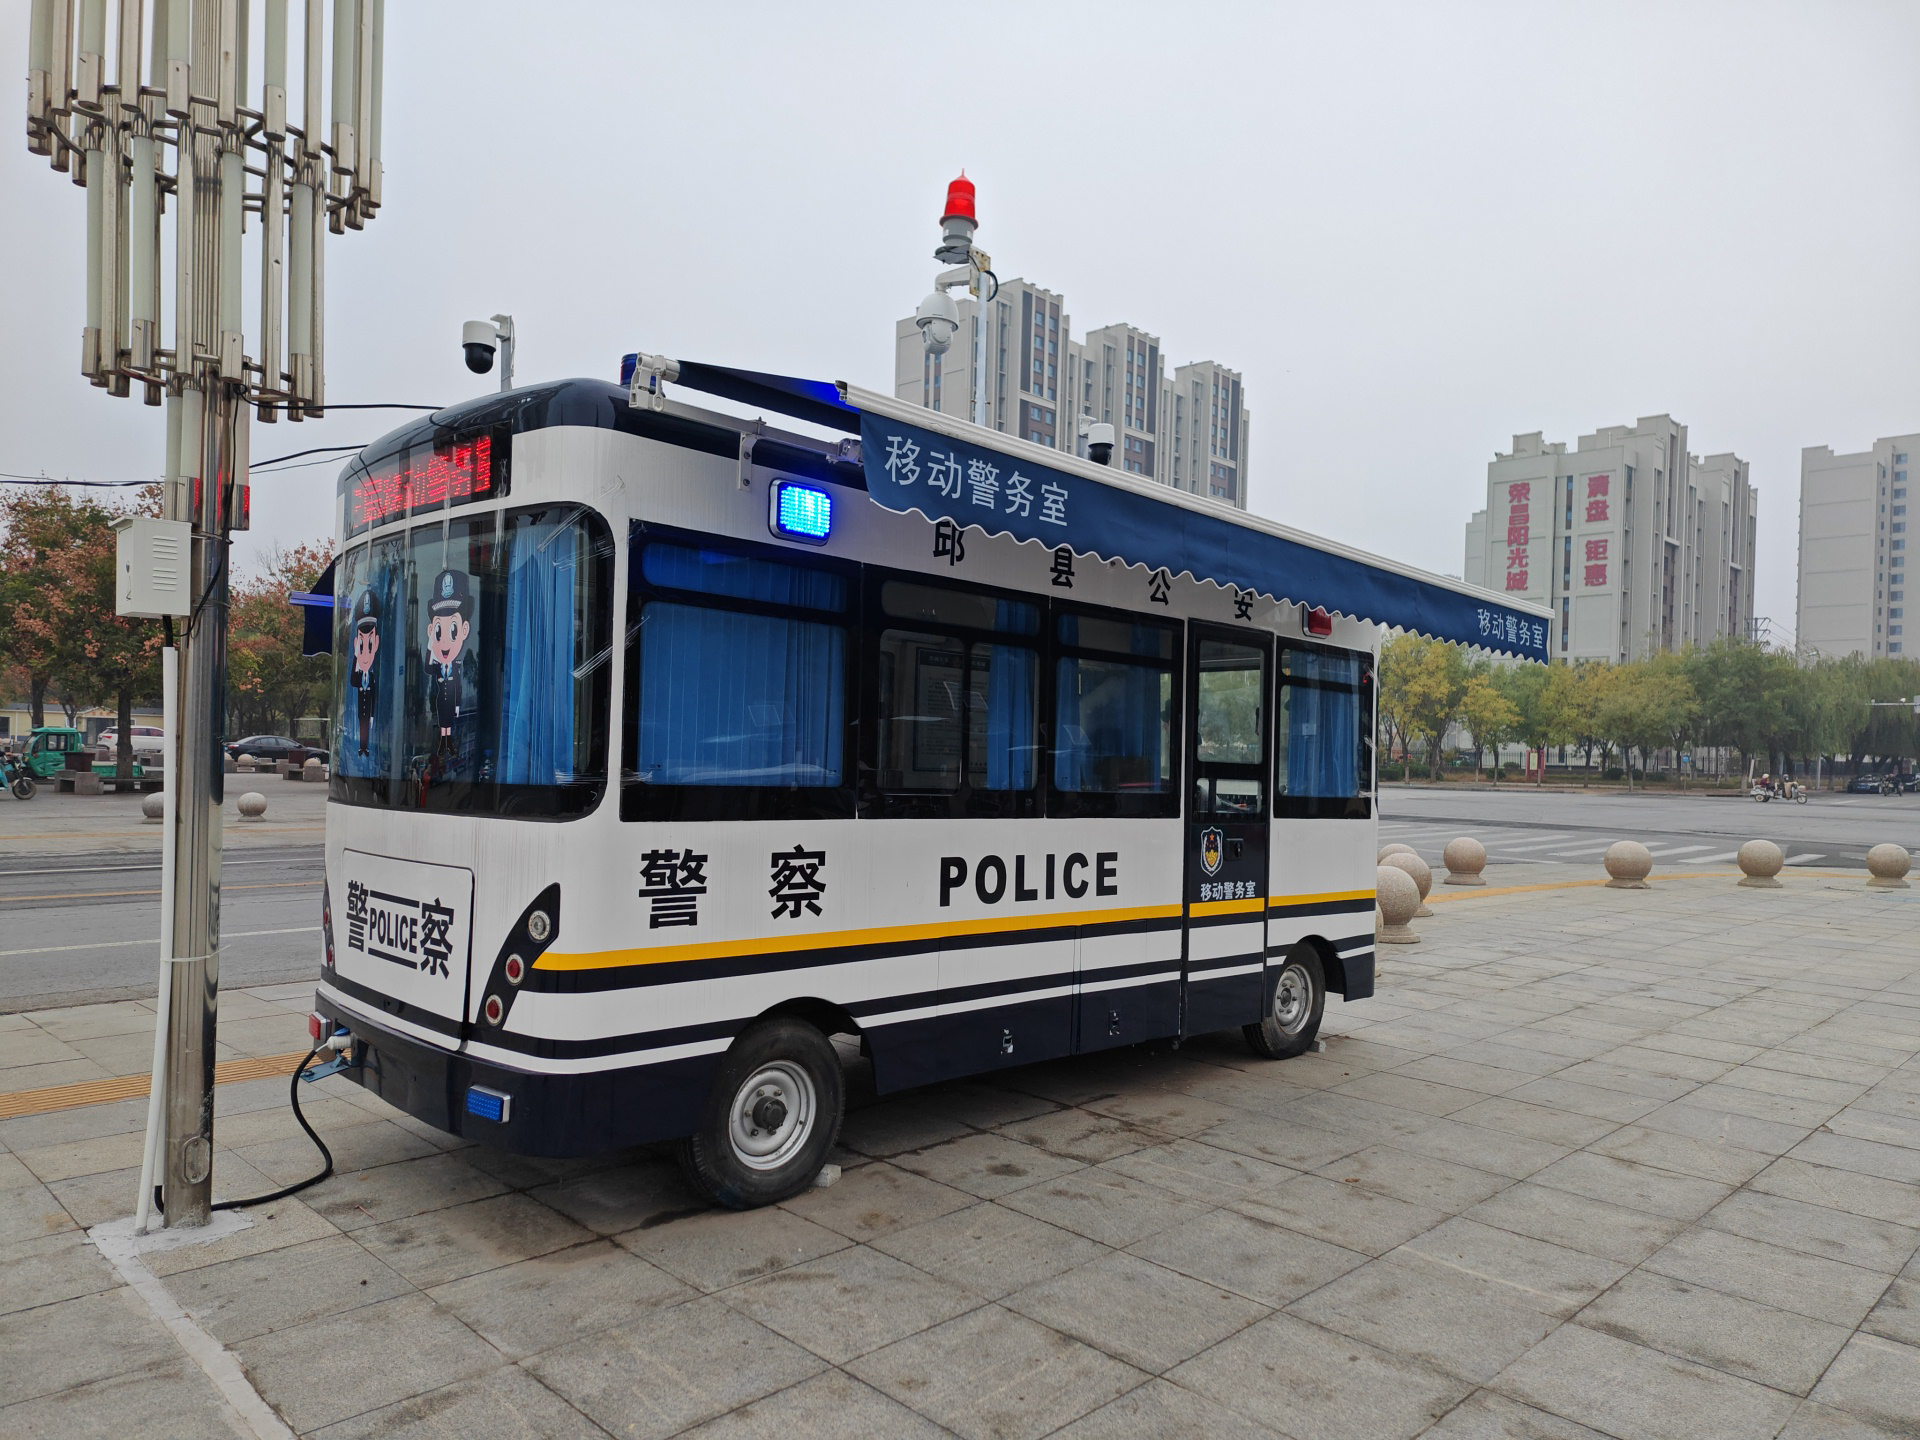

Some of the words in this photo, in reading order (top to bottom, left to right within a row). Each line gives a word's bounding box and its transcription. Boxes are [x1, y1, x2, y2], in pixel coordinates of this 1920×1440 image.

[885, 435, 1069, 527] 移动警务室
[933, 521, 1254, 621] 邱县公安
[1505, 482, 1531, 591] 荣昌阳光城
[1477, 608, 1543, 649] 移动警务室
[346, 880, 369, 953] 警
[369, 907, 418, 955] POLICE
[420, 897, 454, 980] 察
[638, 844, 827, 929] 警察
[939, 852, 1119, 908] POLICE
[1200, 880, 1256, 901] 移动警务室
